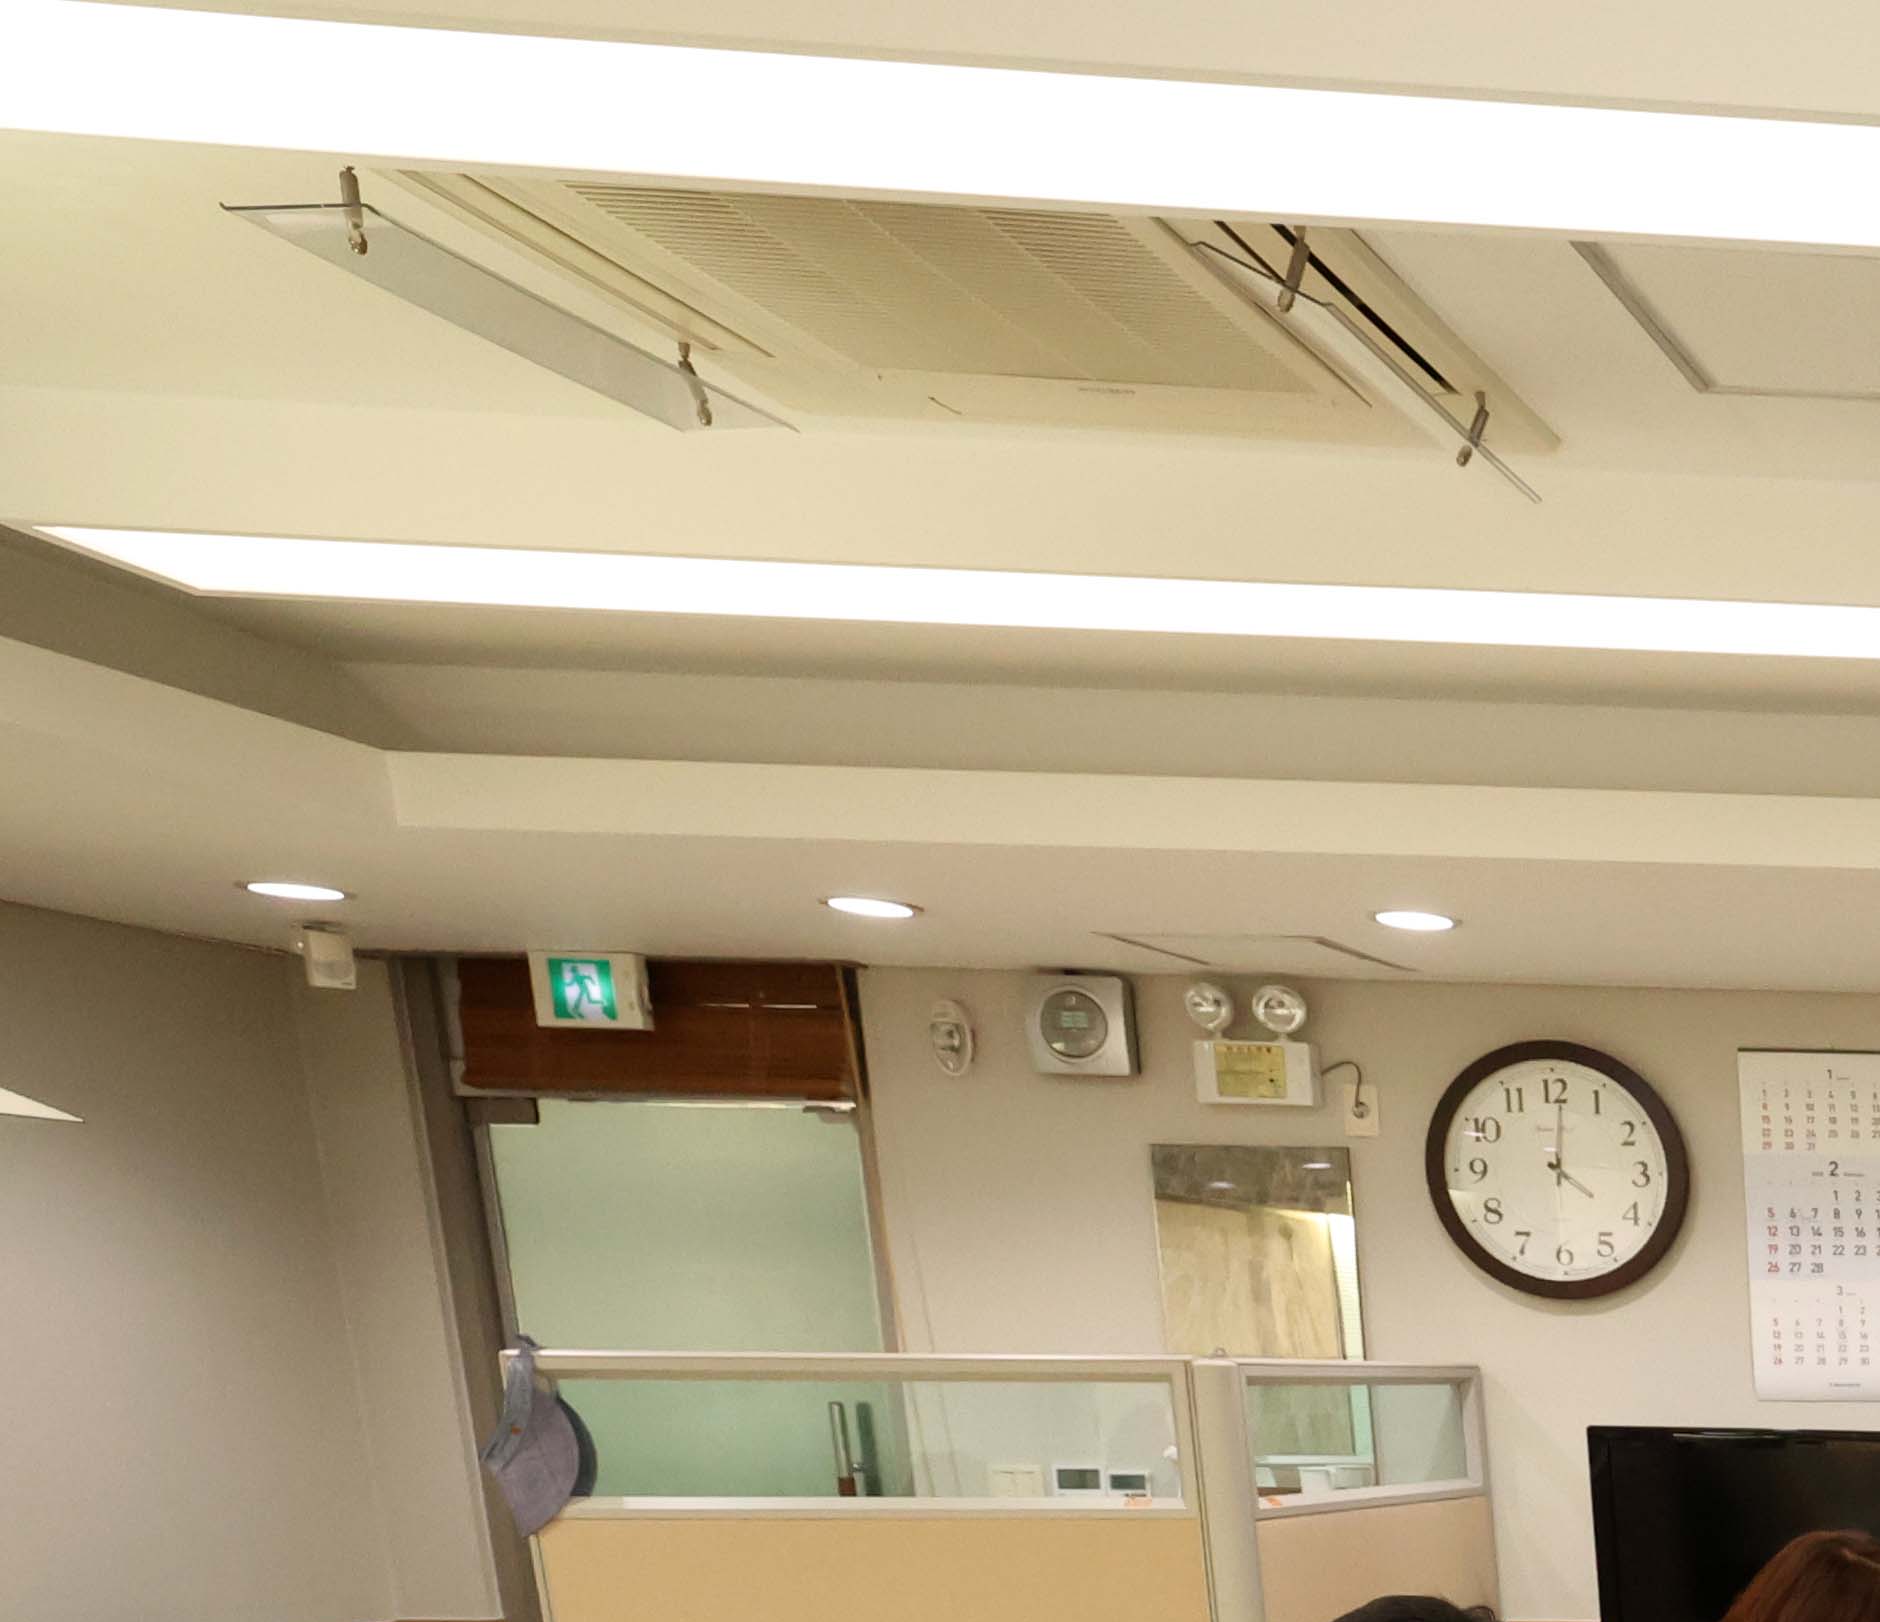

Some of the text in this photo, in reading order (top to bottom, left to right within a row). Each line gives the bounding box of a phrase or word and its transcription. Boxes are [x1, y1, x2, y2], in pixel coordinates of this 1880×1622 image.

[1503, 1087, 1525, 1113] 11
[1542, 1078, 1568, 1105] 12
[1593, 1089, 1601, 1115] 1
[1471, 1116, 1501, 1144] 10
[1620, 1121, 1636, 1147] 2
[1469, 1158, 1488, 1184] 9
[1631, 1160, 1651, 1188] 3
[1828, 1160, 1840, 1177] 2
[1483, 1198, 1503, 1225] 8
[1622, 1201, 1641, 1227] 4
[1514, 1231, 1532, 1256] 7
[1556, 1244, 1574, 1267] 6
[1596, 1232, 1615, 1258] 5
